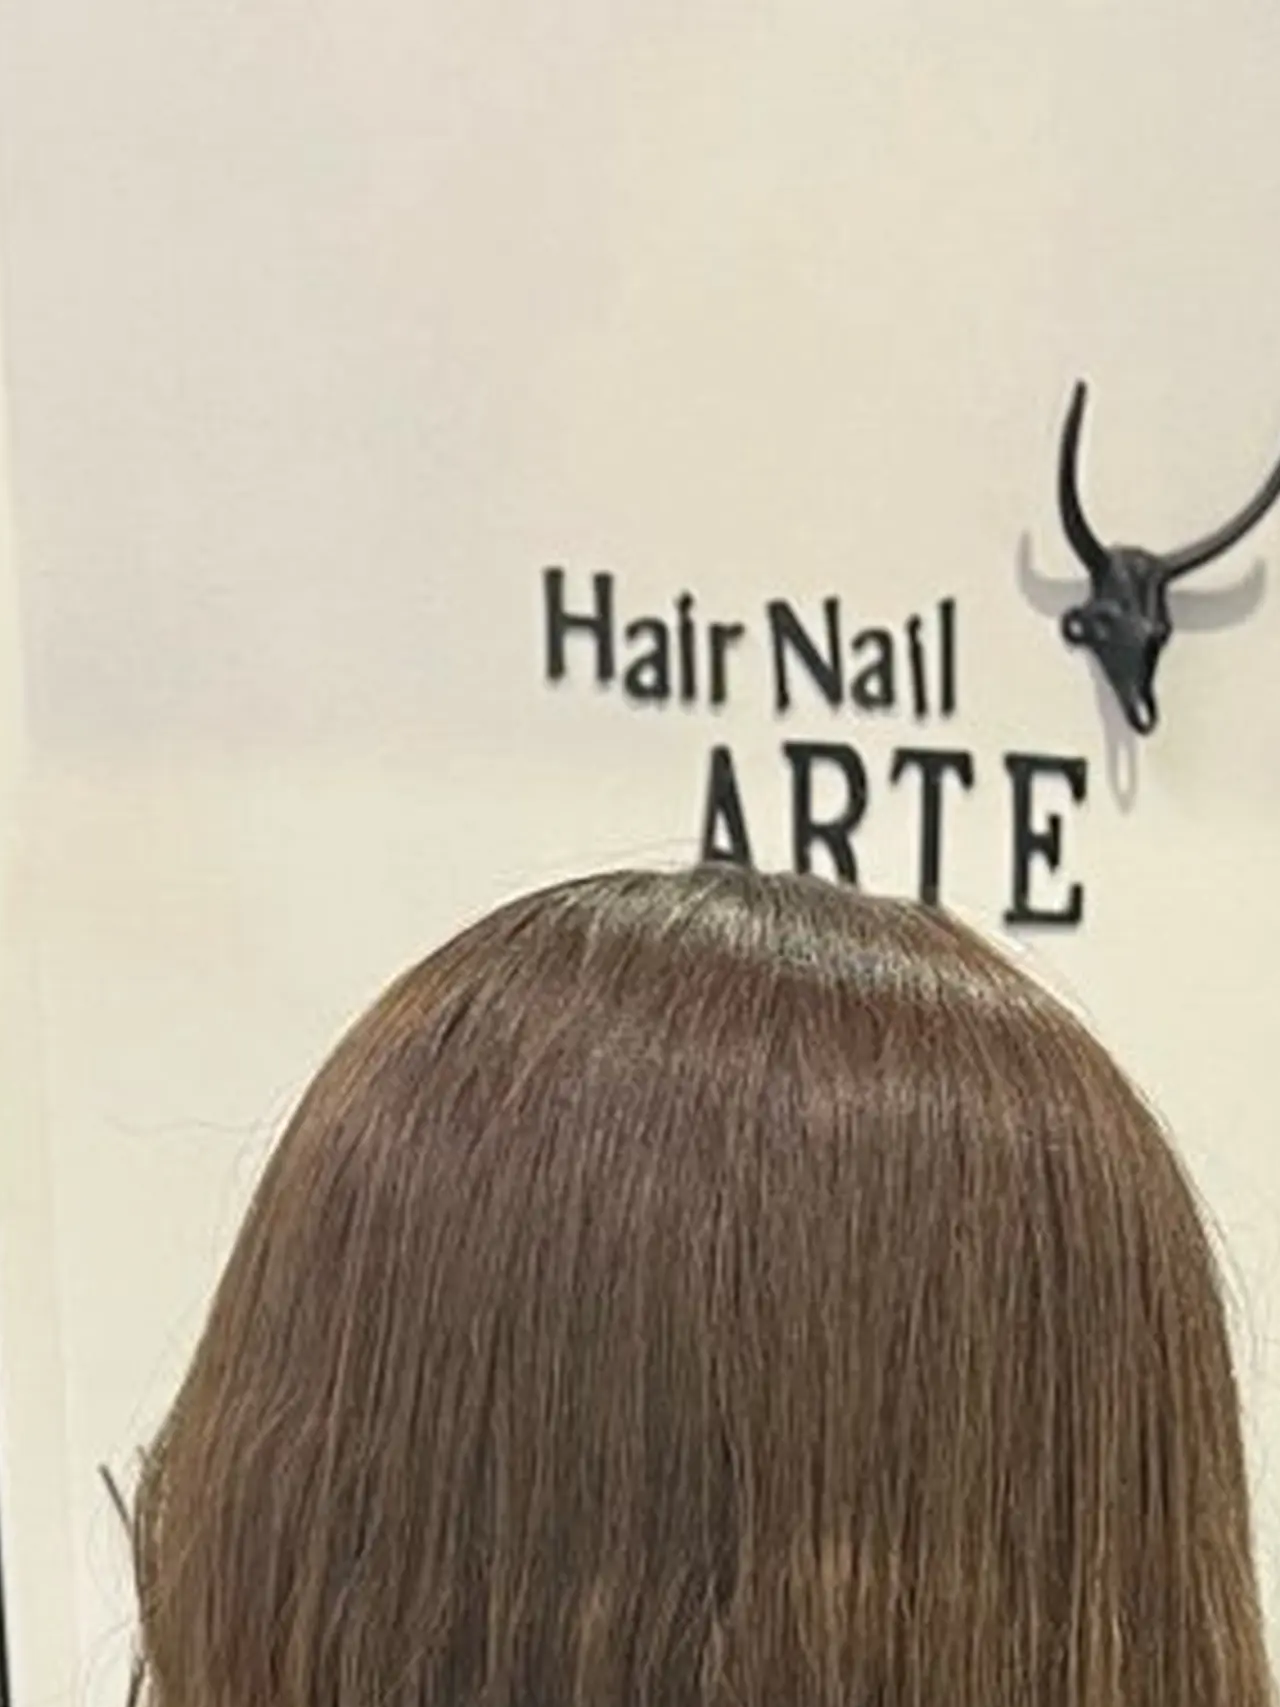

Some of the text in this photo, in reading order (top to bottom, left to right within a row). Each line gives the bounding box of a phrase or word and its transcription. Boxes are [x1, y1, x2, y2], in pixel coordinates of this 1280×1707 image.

[543, 567, 957, 718] Hair Nail
[698, 739, 1089, 926] ARTE
